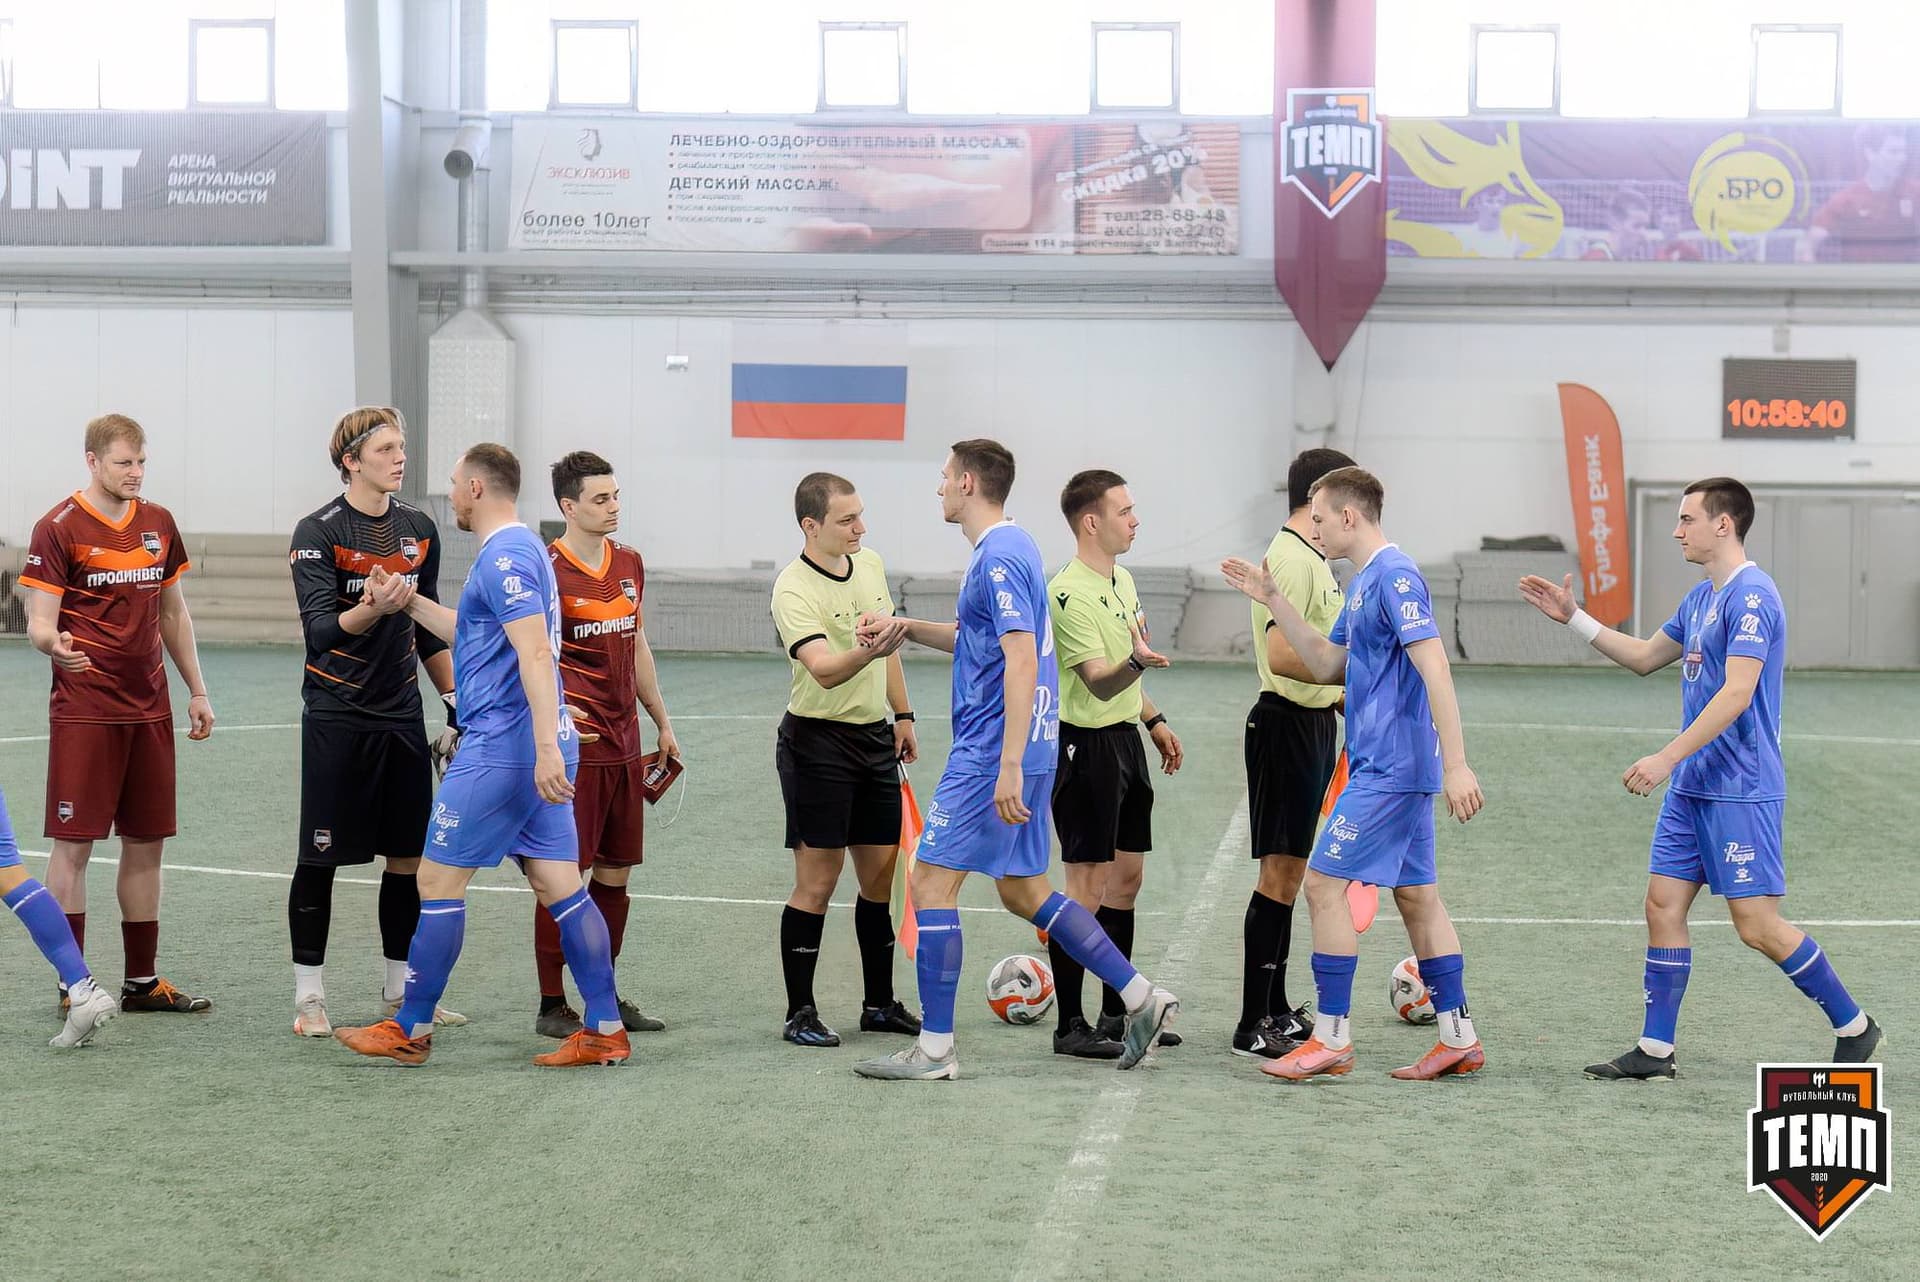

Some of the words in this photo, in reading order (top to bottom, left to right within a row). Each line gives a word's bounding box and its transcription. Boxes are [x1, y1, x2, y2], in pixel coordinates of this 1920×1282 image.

[1290, 124, 1373, 169] ТЕМП
[168, 153, 216, 168] АРЕНА
[168, 168, 276, 186] ВИРТУАЛЬНОЙ
[548, 167, 631, 180] ЭКСКЛЮЗИВ
[669, 174, 749, 191] ДЕТСКИЙ
[757, 178, 840, 191] МАССАЖ:
[168, 188, 267, 205] РЕАЛЬНОСТИ
[523, 210, 585, 228] более
[1728, 399, 1847, 428] 10:58:40
[298, 549, 322, 560] ПСБ
[1589, 506, 1618, 596] Альфа
[574, 616, 636, 640] ПРОДИНВЕ
